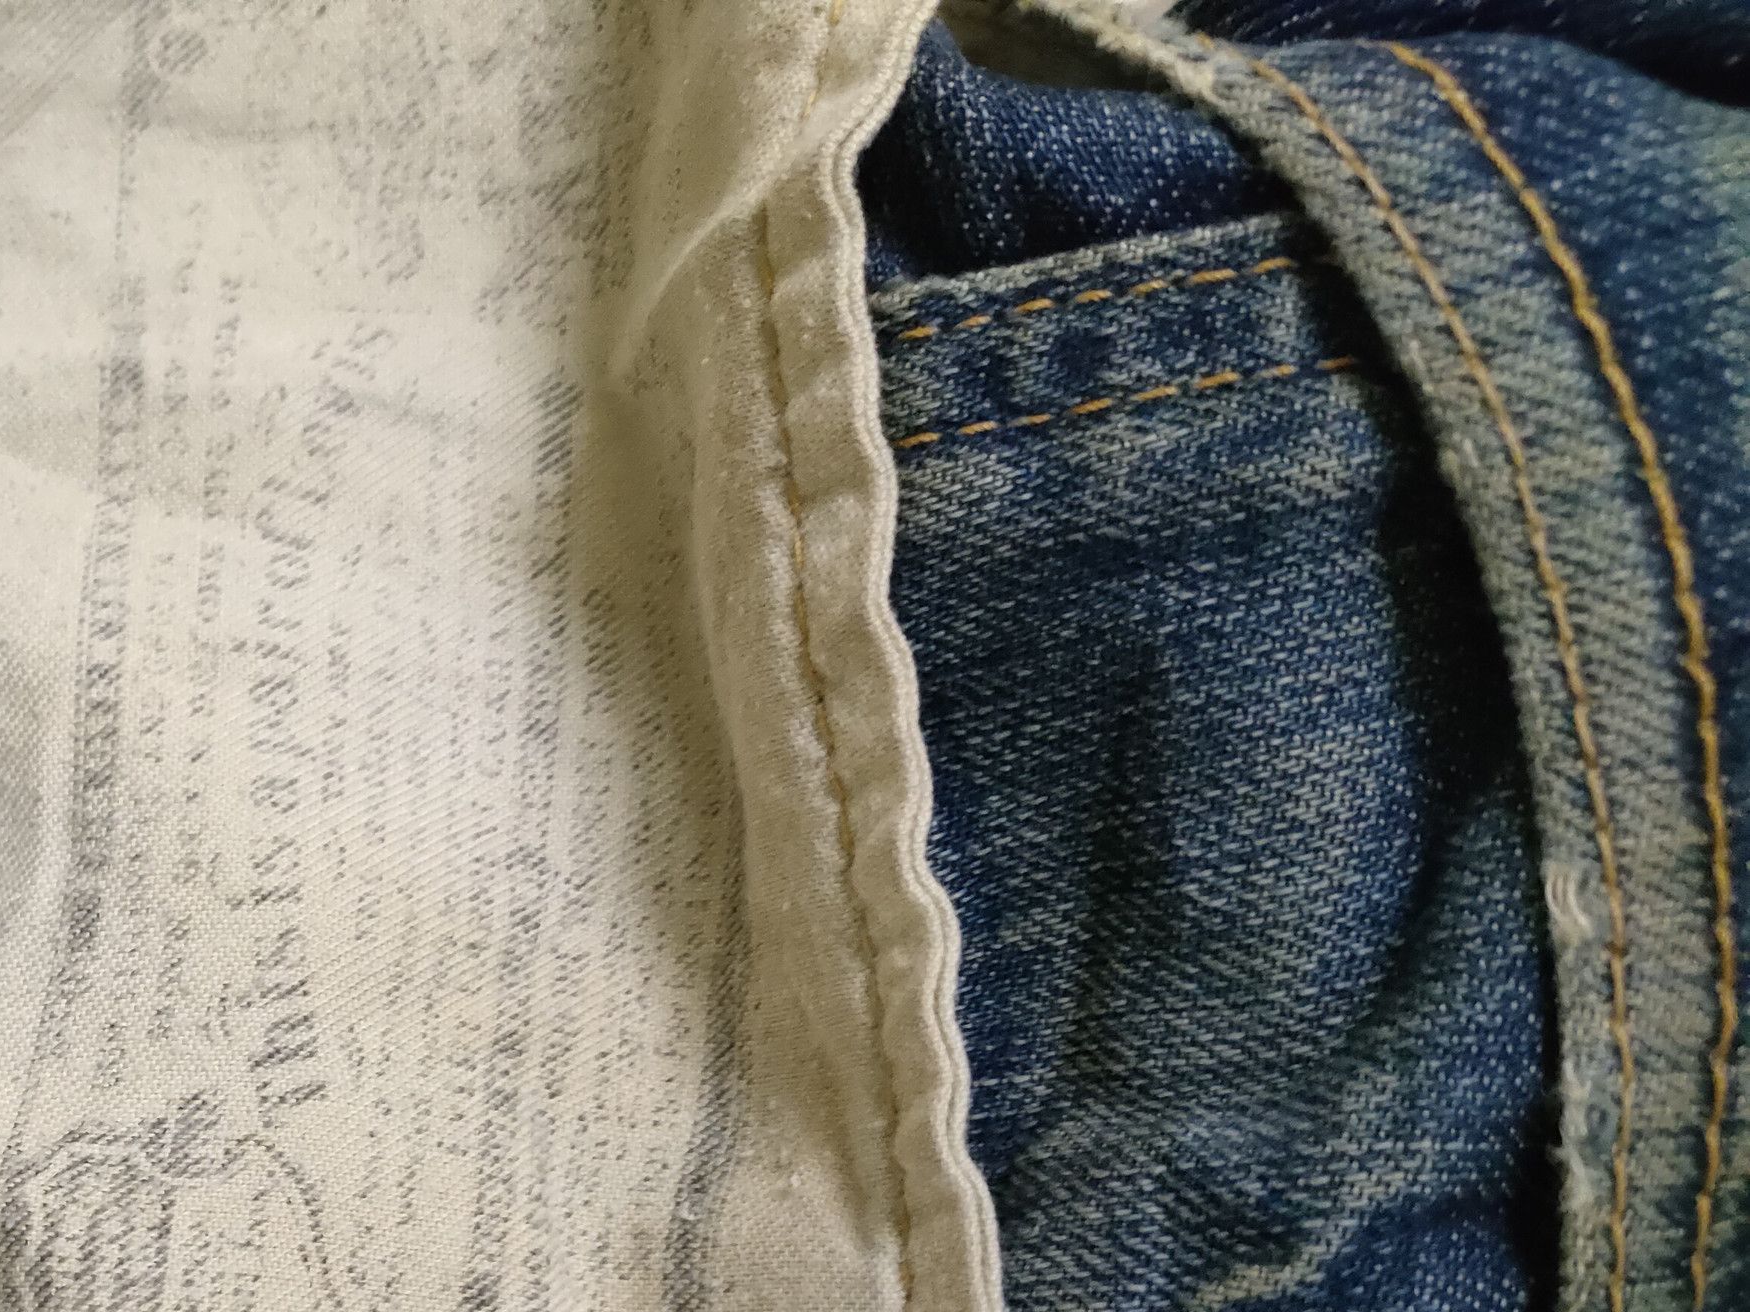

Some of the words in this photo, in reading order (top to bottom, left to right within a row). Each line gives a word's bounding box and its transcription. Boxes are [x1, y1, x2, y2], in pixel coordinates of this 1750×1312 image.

[227, 597, 313, 757] pair
[248, 771, 300, 815] a
[224, 833, 304, 911] is
[233, 924, 328, 1129] This
